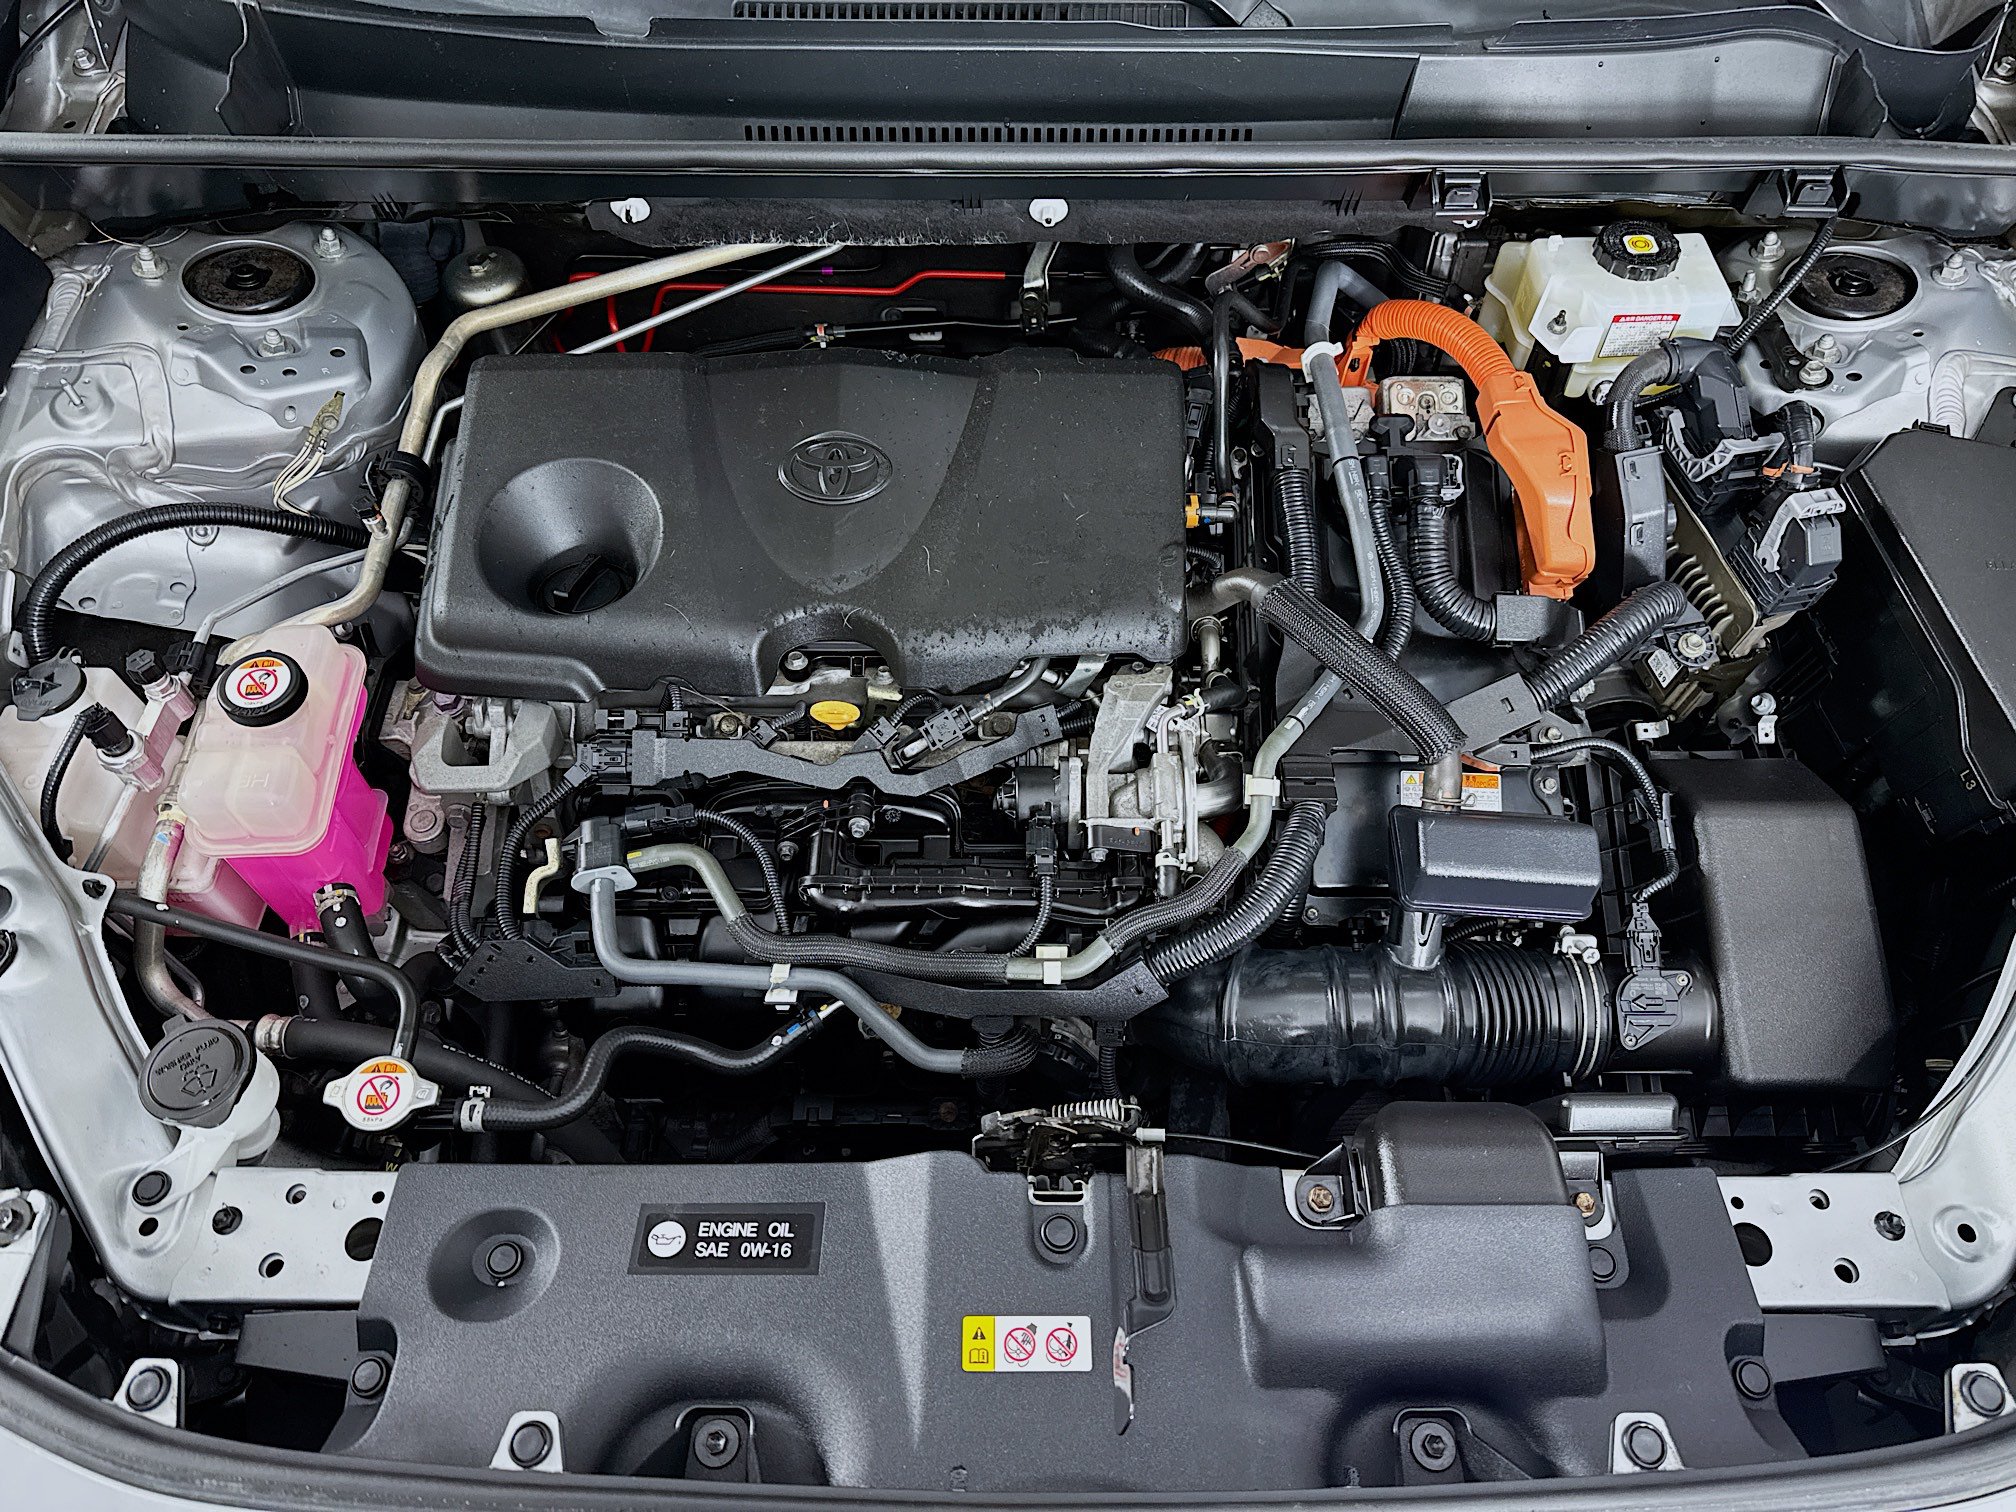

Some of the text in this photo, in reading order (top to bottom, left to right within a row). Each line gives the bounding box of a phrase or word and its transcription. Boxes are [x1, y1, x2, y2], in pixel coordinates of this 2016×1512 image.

[1960, 769, 1977, 791] L3
[698, 1222, 795, 1238] ENGINE OIL
[694, 1242, 792, 1258] SAE 0W-16
